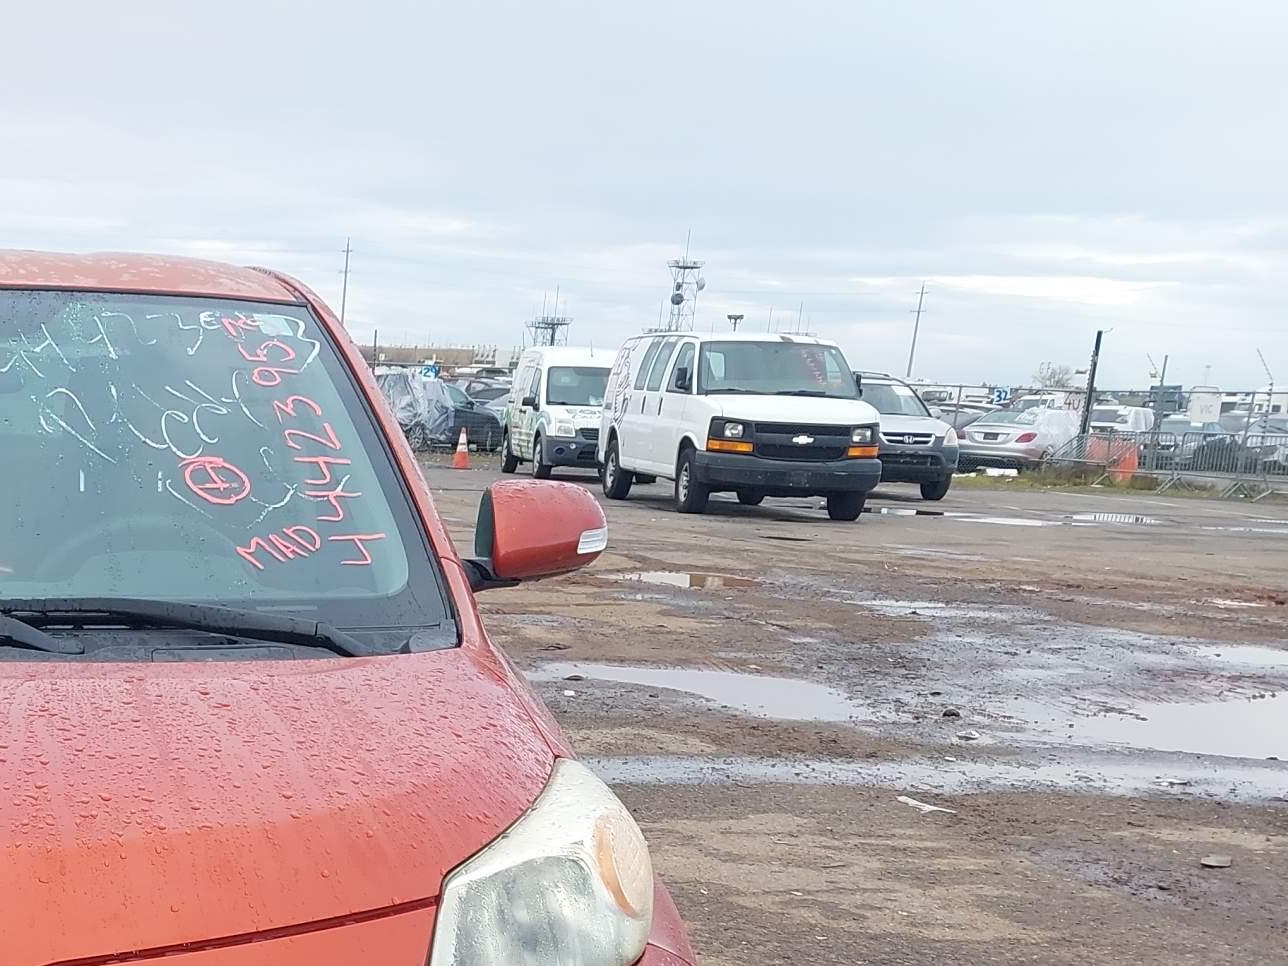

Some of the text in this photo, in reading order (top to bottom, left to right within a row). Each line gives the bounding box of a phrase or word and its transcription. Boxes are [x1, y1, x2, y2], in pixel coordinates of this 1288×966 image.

[423, 365, 440, 378] 29
[996, 389, 1008, 402] 32
[236, 525, 321, 570] MAD
